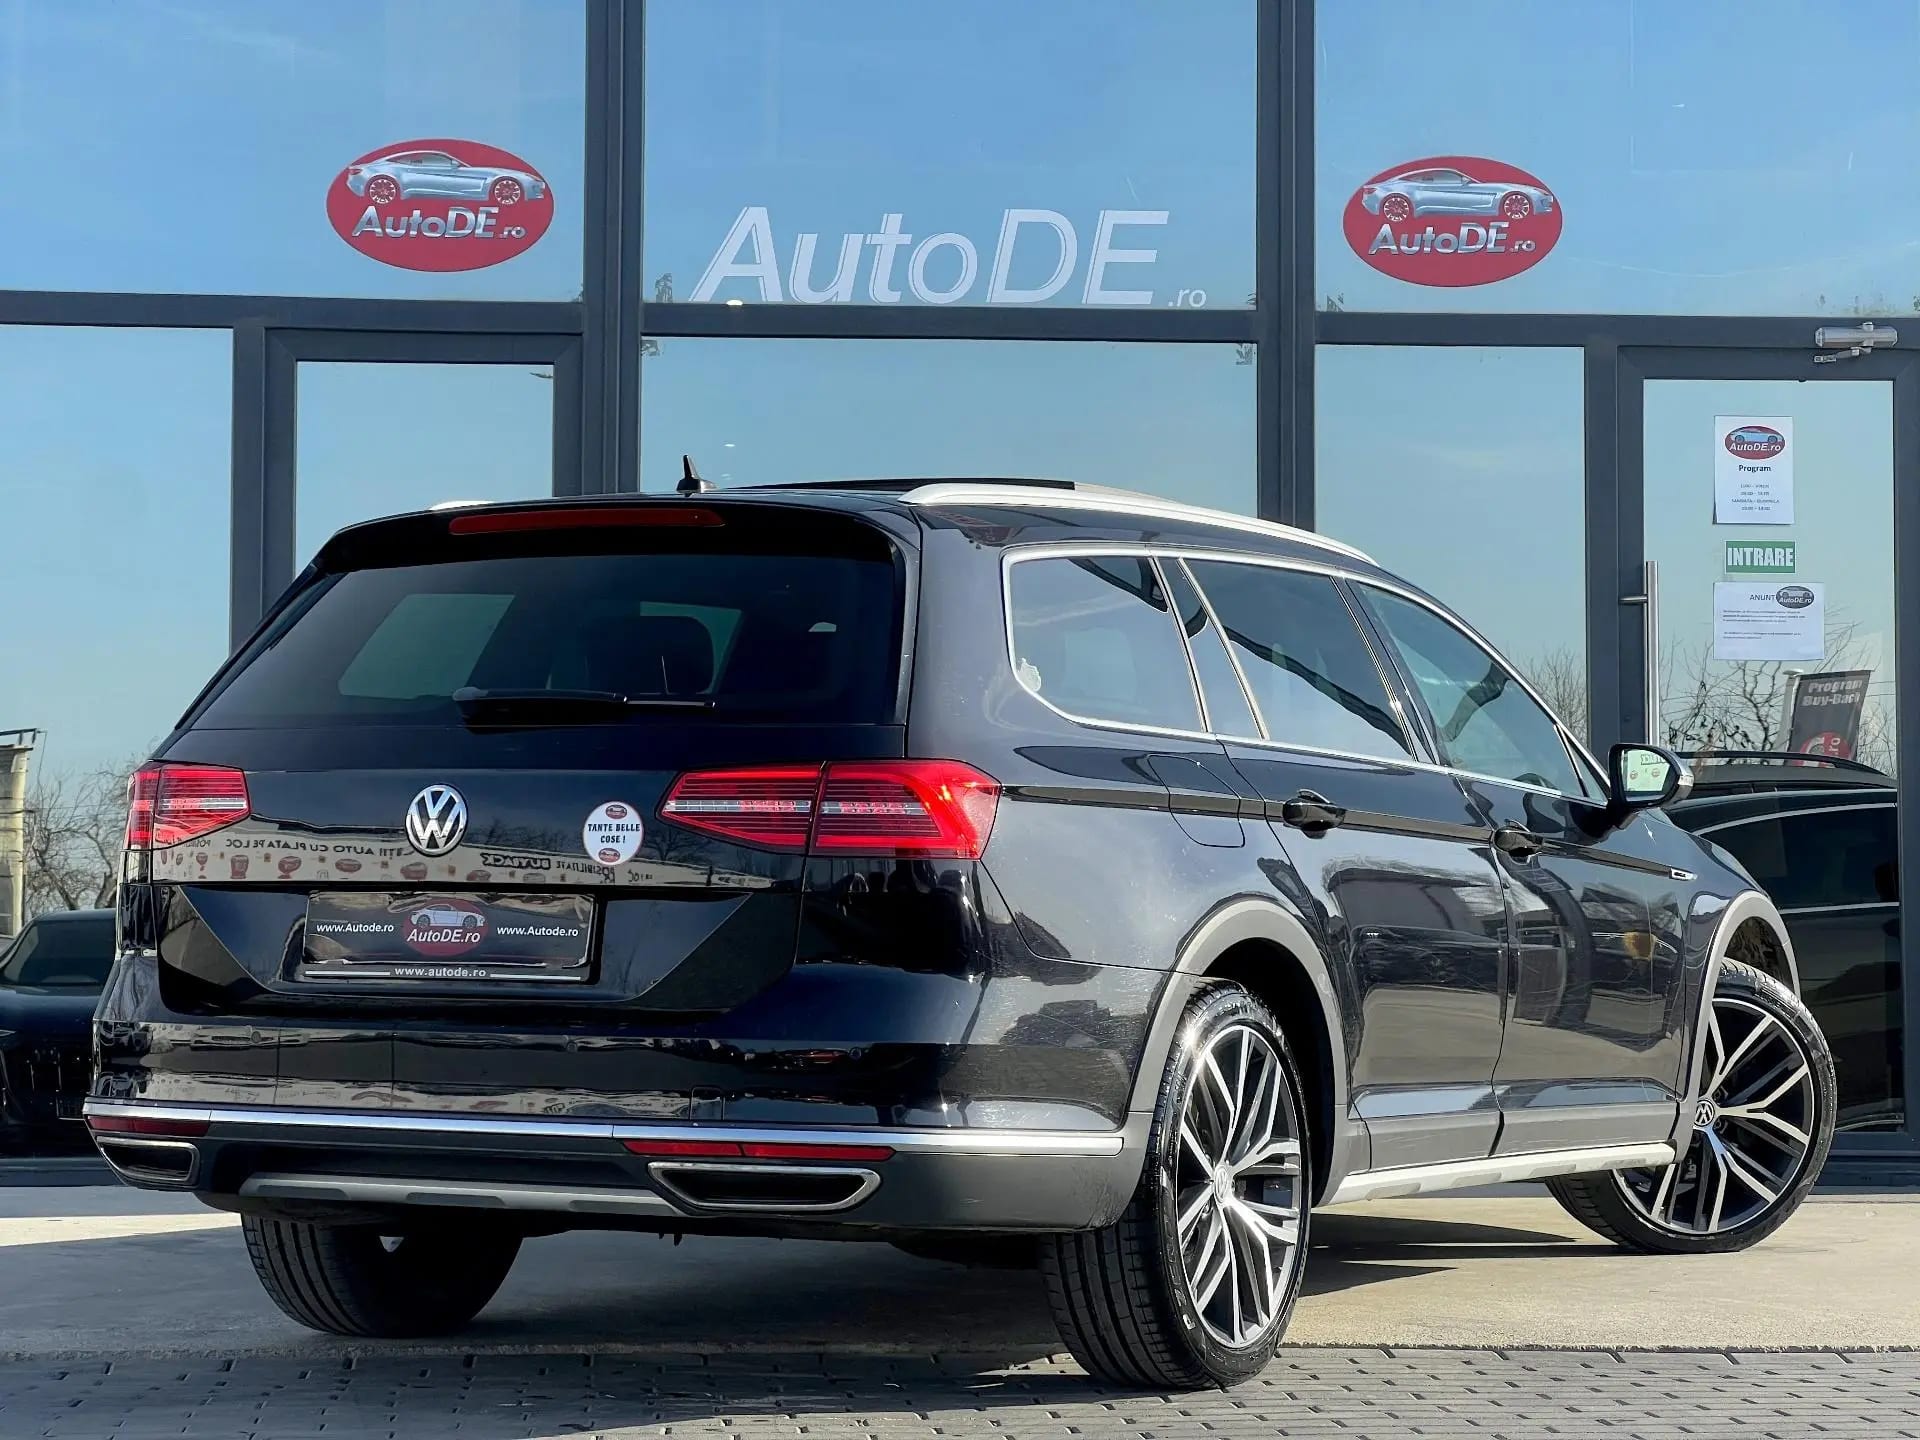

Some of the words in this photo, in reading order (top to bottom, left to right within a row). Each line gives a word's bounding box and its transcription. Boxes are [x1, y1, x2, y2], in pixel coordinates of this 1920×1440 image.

[1738, 464, 1772, 473] Program
[1727, 547, 1794, 567] INTRARE
[1808, 680, 1863, 694] Program
[587, 823, 613, 832] TANTE
[600, 835, 621, 844] COSE
[316, 922, 395, 932] www.Autode.ro
[496, 926, 579, 937] www.Autode.ro
[407, 928, 480, 943] AutoDE.ro
[394, 967, 487, 977] www.autode.ro
